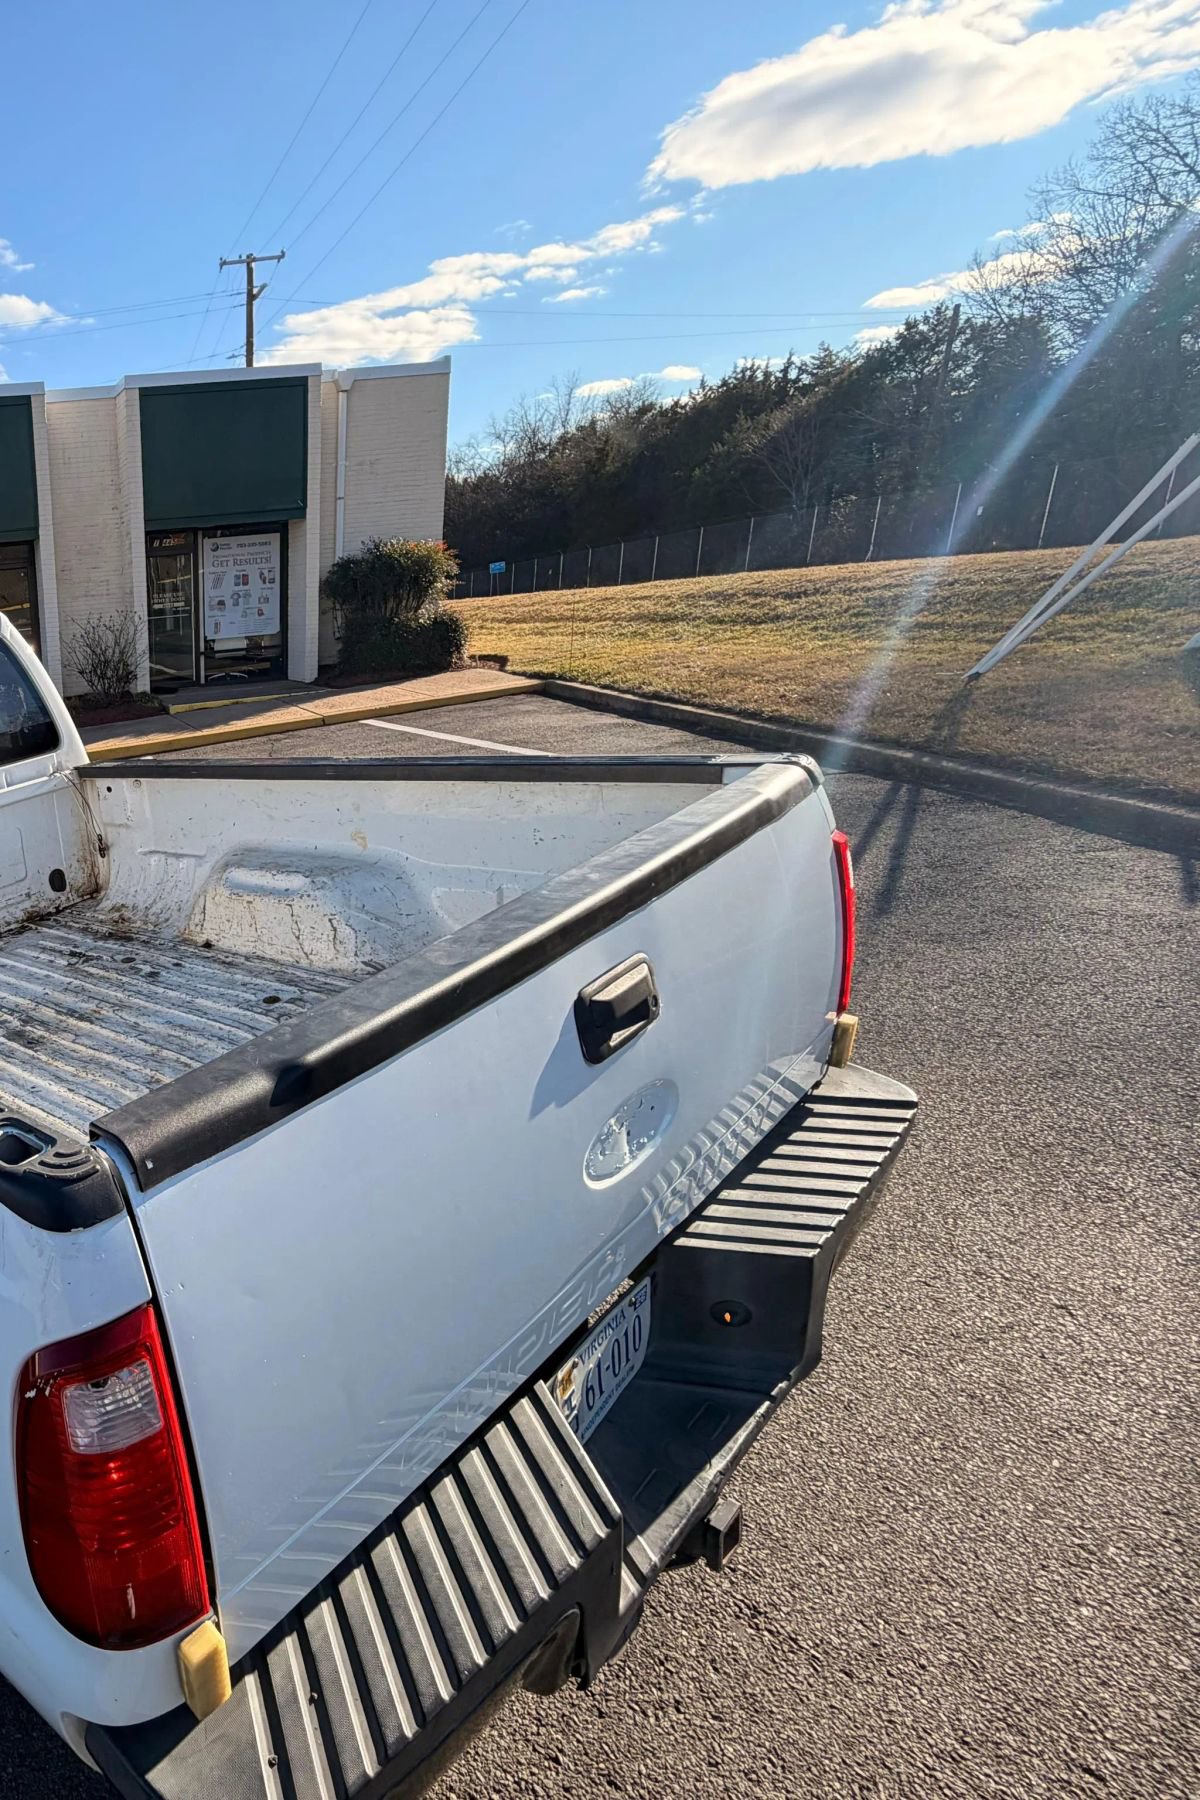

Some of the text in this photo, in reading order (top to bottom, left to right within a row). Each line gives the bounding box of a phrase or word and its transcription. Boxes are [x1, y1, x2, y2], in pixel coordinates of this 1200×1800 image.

[211, 556, 272, 568] GET RESULTS!
[578, 1308, 627, 1366] VIRGINIA
[584, 1314, 643, 1412] 61-010
